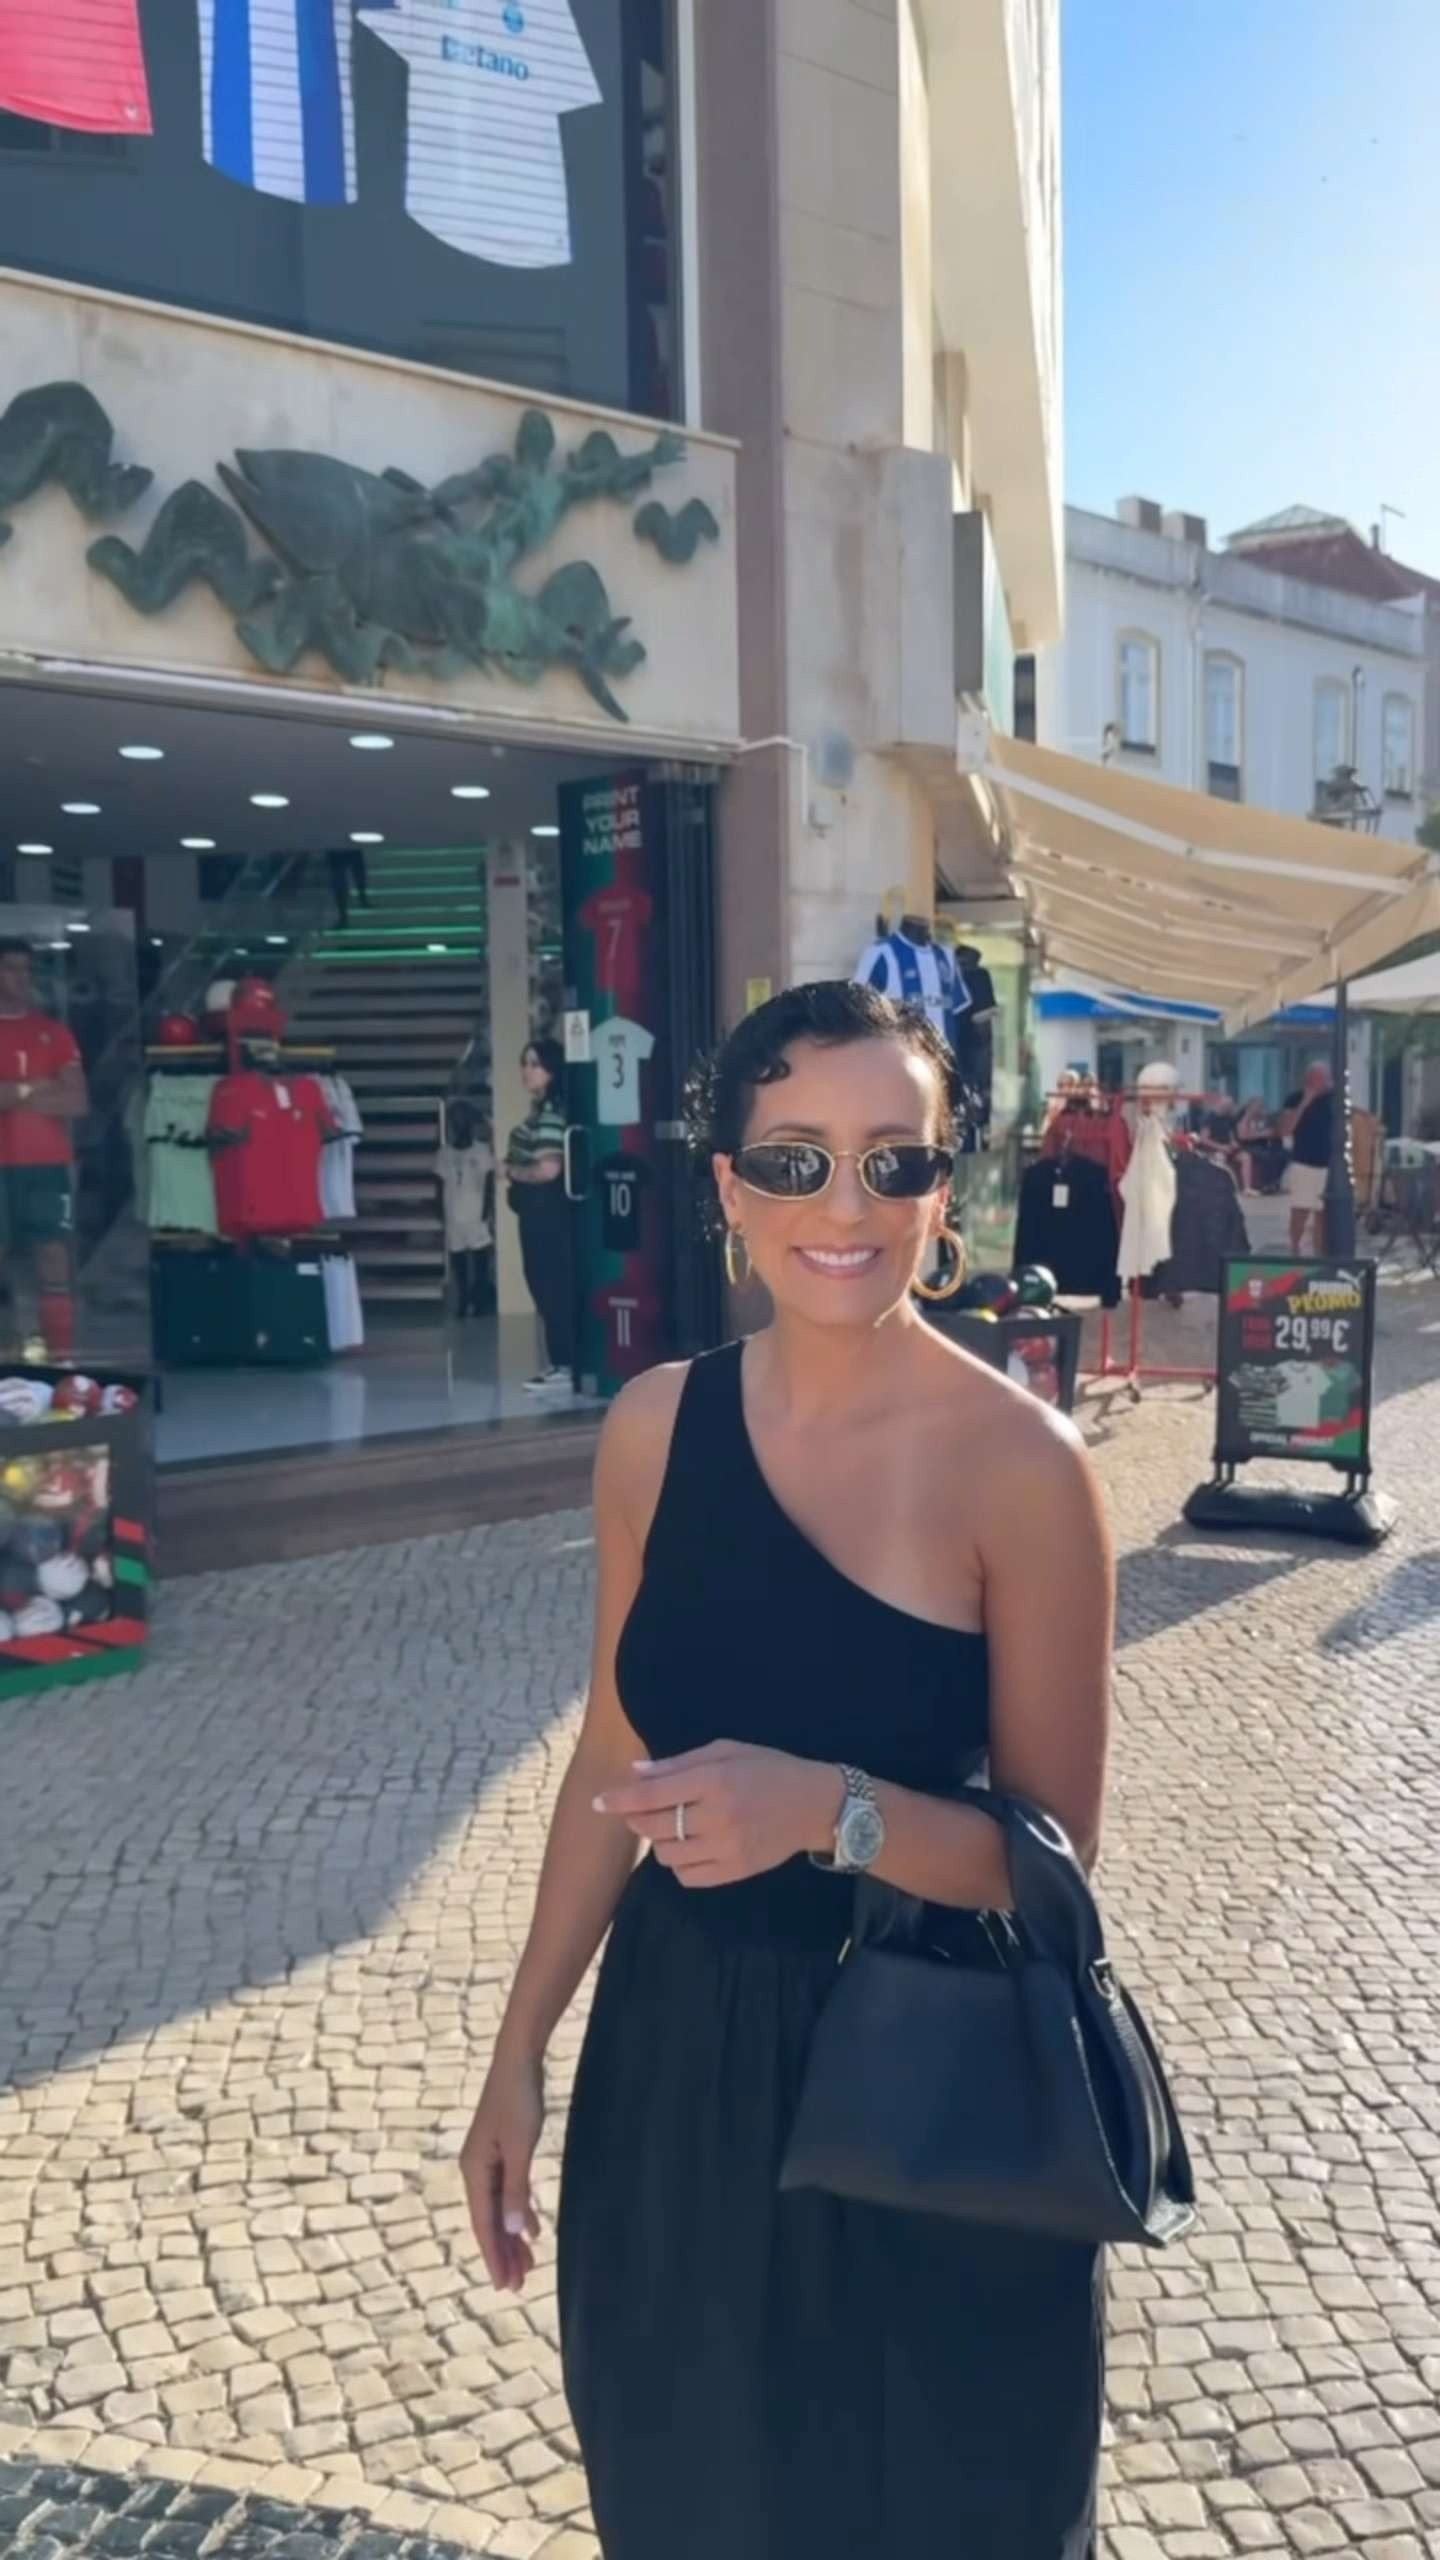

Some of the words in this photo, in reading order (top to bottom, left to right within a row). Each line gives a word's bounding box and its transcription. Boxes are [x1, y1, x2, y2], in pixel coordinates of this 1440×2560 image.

[585, 810, 639, 833] YOUR
[583, 831, 642, 855] NAME
[608, 918, 622, 960] 7
[611, 1053, 625, 1088] 3
[610, 1183, 631, 1217] 10
[1287, 1289, 1362, 1314] PROMO
